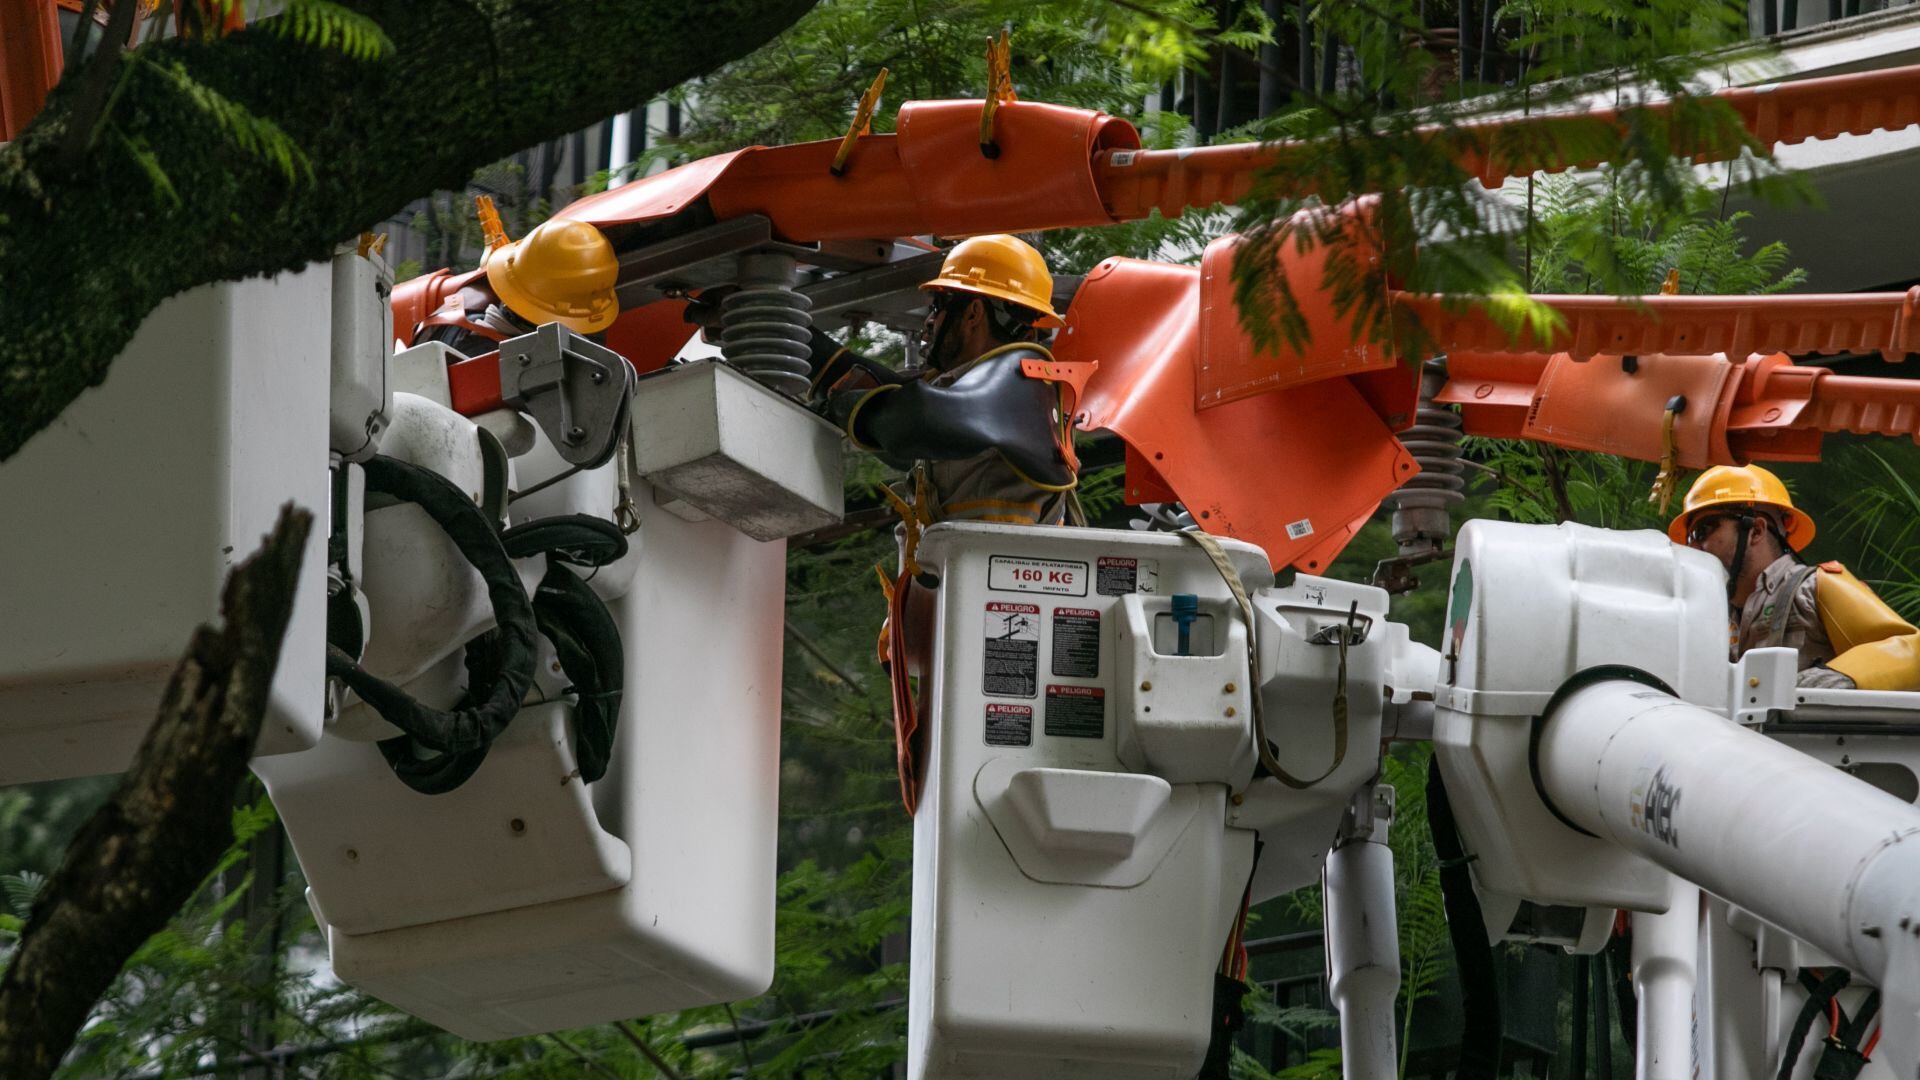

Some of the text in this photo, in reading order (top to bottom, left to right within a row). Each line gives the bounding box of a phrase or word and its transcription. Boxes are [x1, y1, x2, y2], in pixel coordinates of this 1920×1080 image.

[1106, 559, 1136, 567] PELIGRO
[1012, 569, 1074, 584] 160 KG
[1000, 604, 1035, 613] PELIGRO
[1065, 608, 1096, 616] PELIGRO
[1060, 687, 1092, 695] PELIGRO
[997, 705, 1031, 714] PELIGRO
